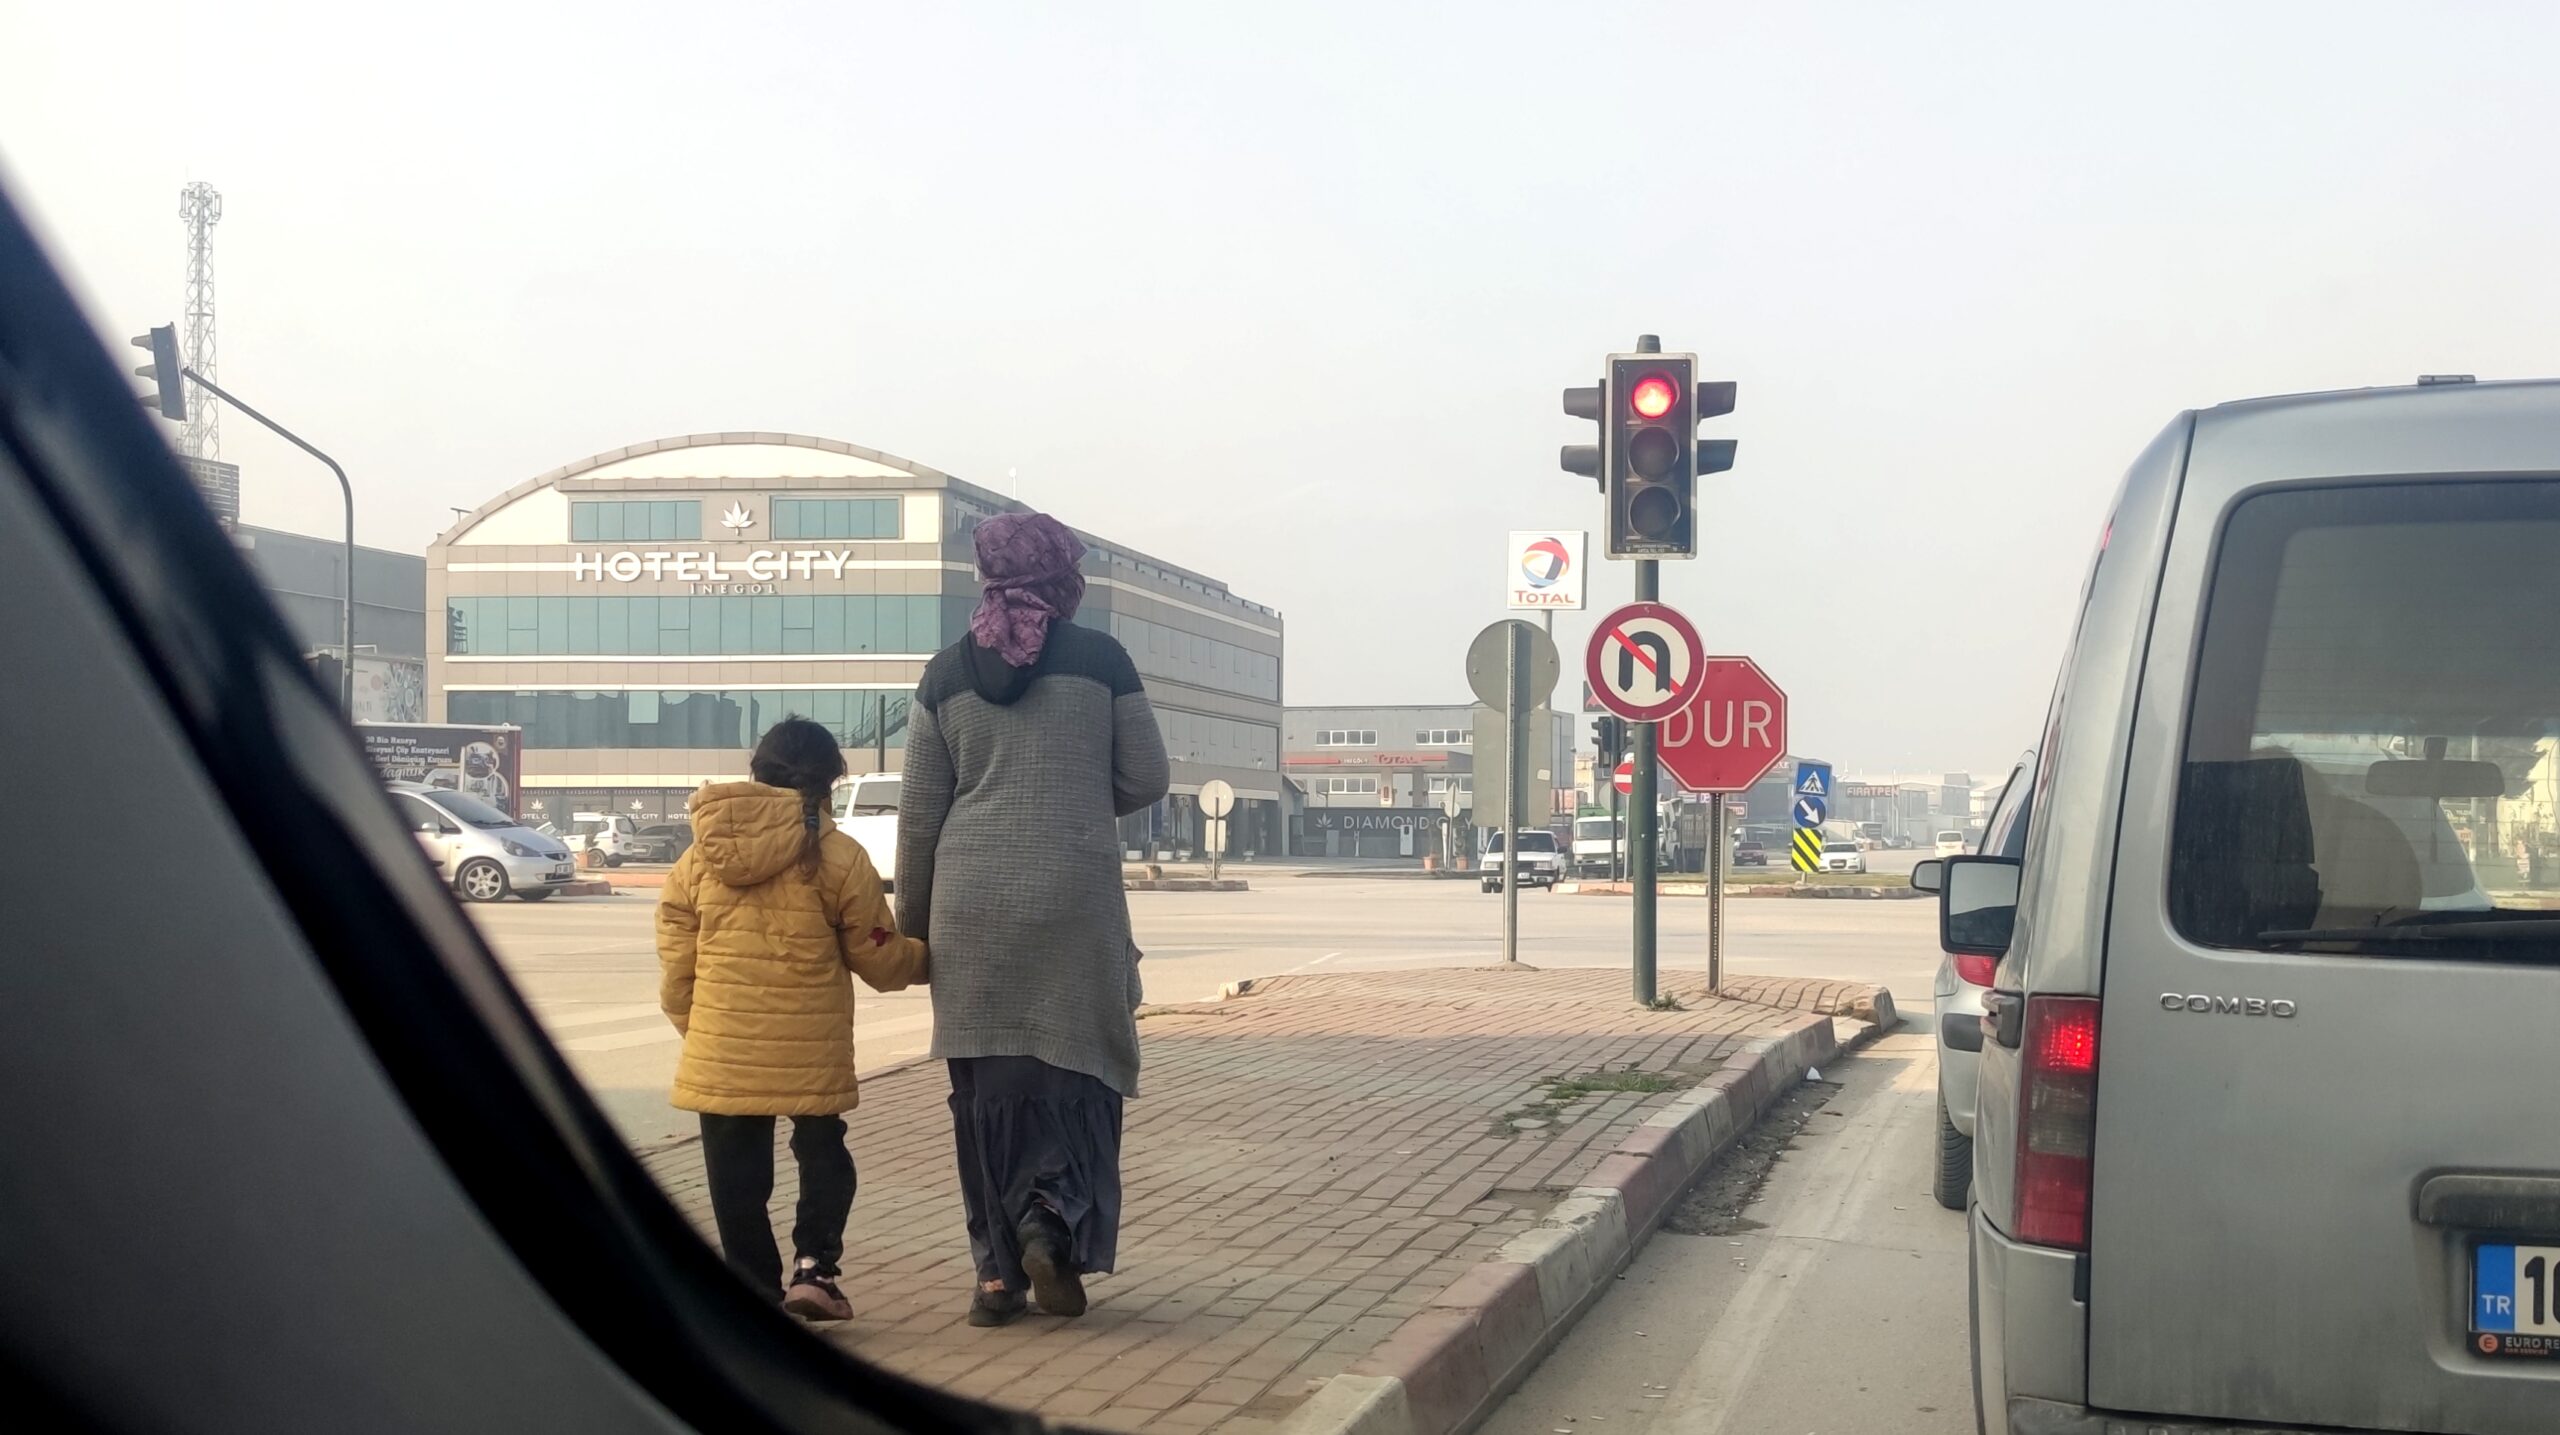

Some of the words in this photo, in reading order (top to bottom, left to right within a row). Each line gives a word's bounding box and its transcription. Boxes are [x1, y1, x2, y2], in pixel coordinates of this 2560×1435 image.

[575, 551, 731, 582] HOTEL
[747, 550, 852, 581] CITY
[1514, 590, 1576, 604] TOTAL
[1663, 700, 1773, 749] DUR
[1343, 815, 1430, 830] DIAMOND
[2159, 992, 2298, 1019] COMBO
[2481, 1294, 2511, 1315] TR
[2524, 1255, 2560, 1326] 1
[2505, 1336, 2541, 1349] EURO
[2544, 1338, 2560, 1350] RE
